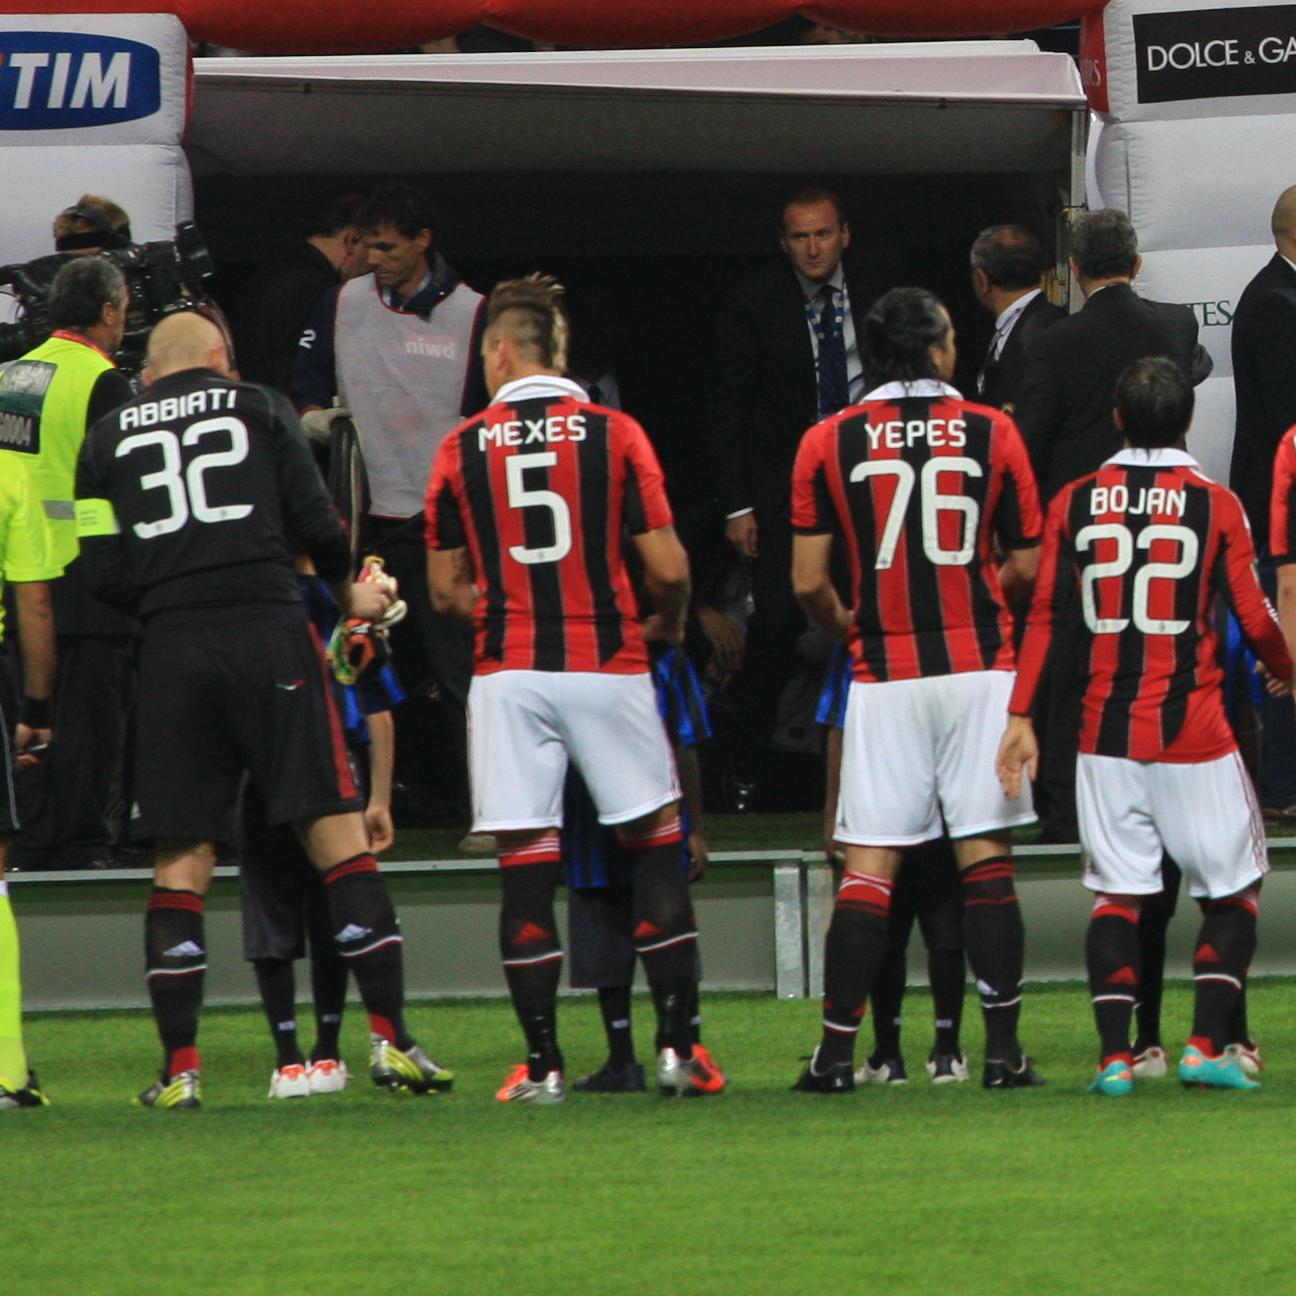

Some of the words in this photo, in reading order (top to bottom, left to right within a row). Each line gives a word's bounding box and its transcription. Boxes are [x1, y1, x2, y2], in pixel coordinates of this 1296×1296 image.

[9, 51, 131, 109] TIM
[1147, 39, 1239, 72] DOLCE
[1243, 50, 1257, 65] &
[119, 388, 237, 431] ABBIATI
[478, 415, 588, 452] MEXES
[864, 418, 968, 450] YEPES
[114, 416, 254, 540] 32
[1089, 485, 1187, 518] BOJAN
[504, 451, 573, 565] 5
[849, 455, 984, 571] 76
[1075, 522, 1199, 636] 22
